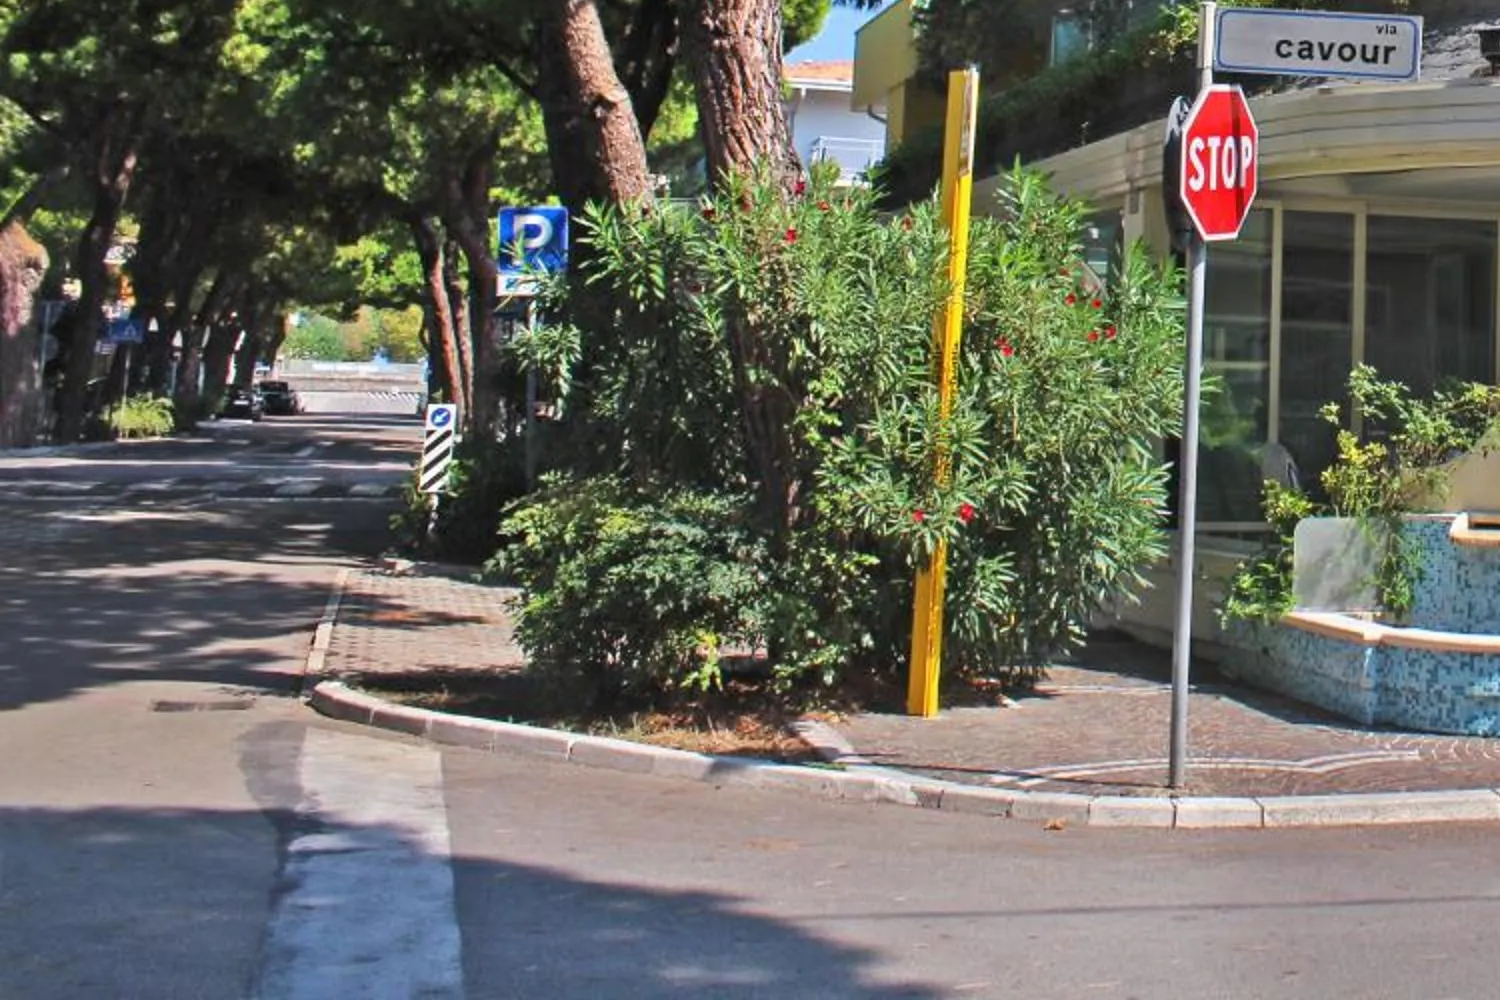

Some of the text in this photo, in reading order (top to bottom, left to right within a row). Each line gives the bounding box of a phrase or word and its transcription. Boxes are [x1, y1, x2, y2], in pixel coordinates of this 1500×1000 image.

[1375, 23, 1397, 35] via
[1275, 39, 1397, 65] cavour
[1188, 135, 1252, 191] STOP
